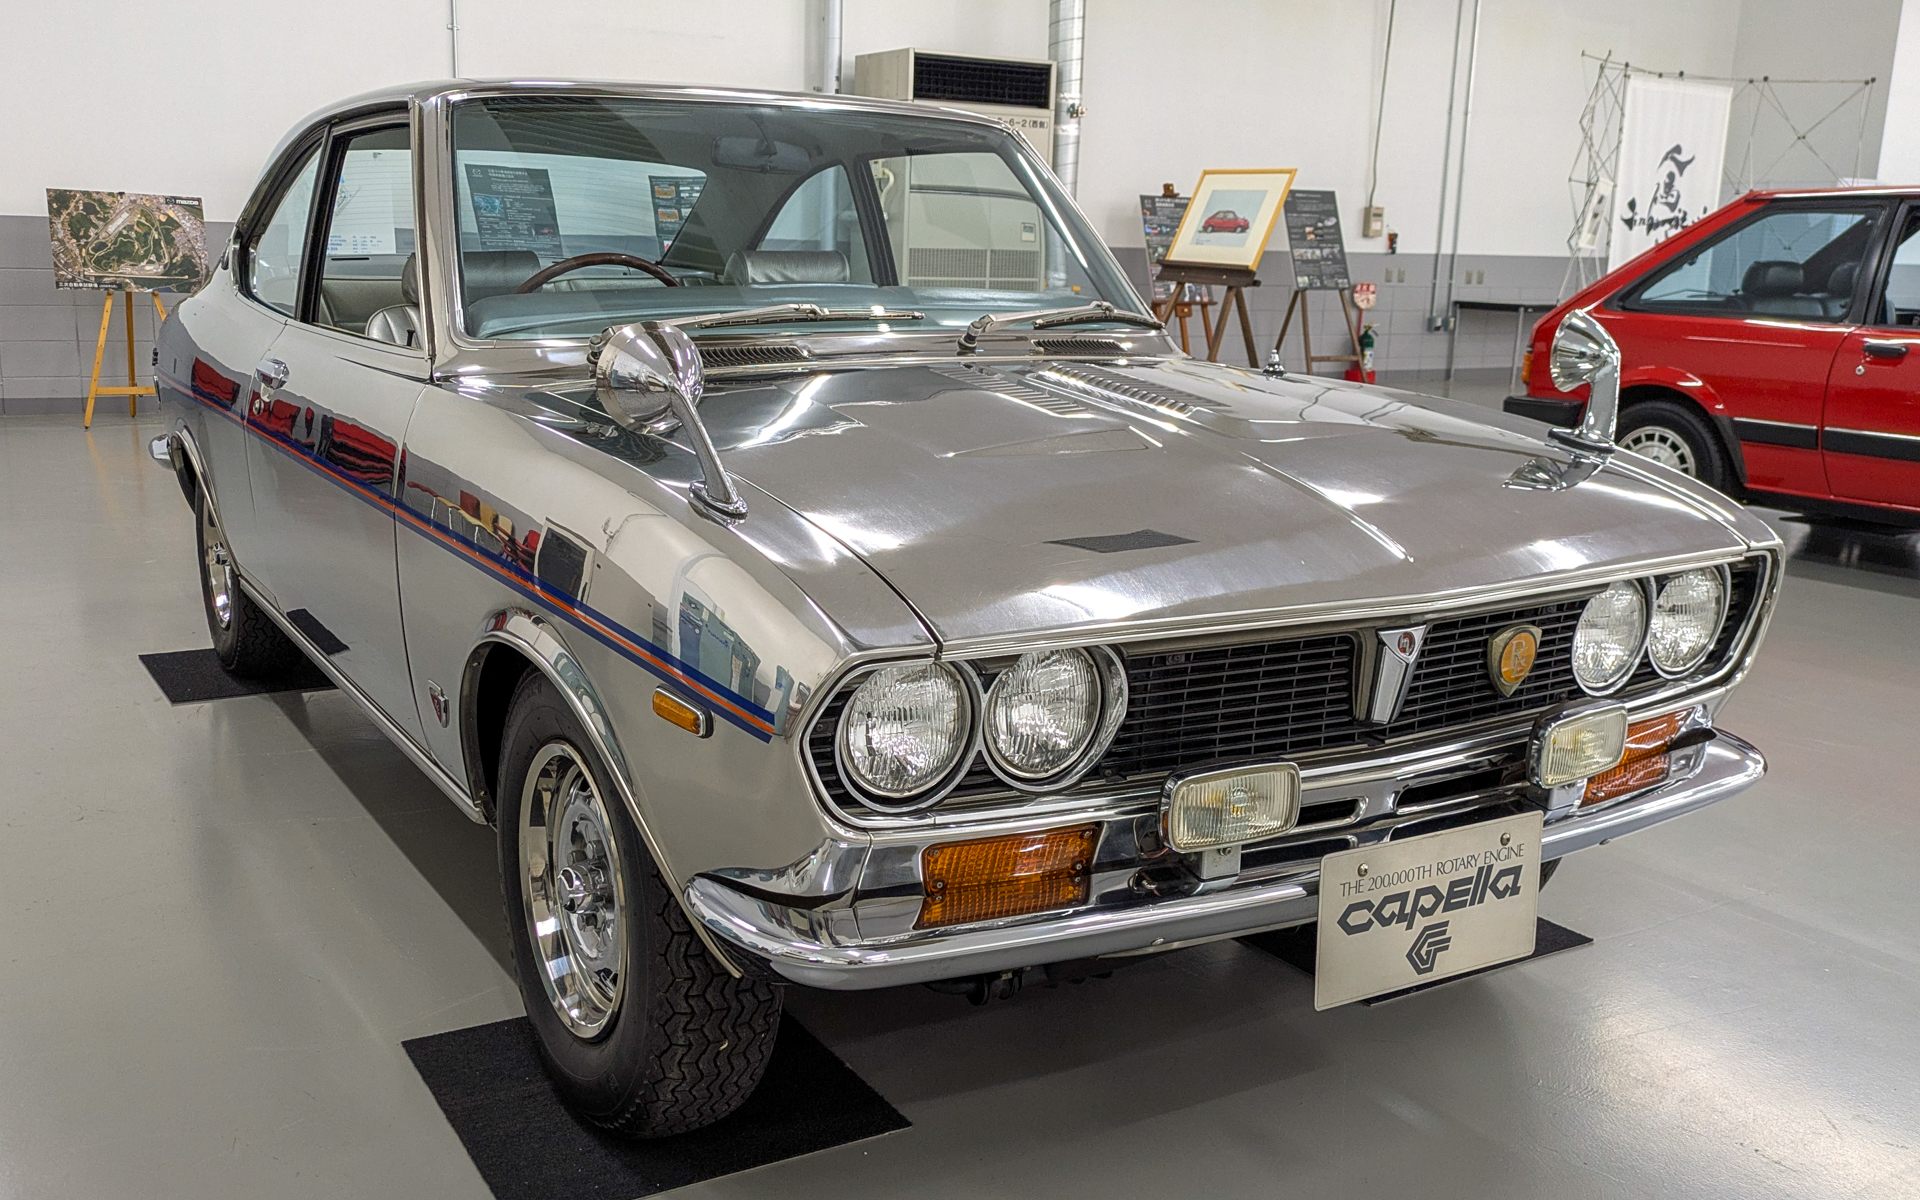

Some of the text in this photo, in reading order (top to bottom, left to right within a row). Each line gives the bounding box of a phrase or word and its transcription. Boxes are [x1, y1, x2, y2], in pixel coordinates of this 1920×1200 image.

[1340, 843, 1525, 898] THE 200,000TH ROTARY ENGINE
